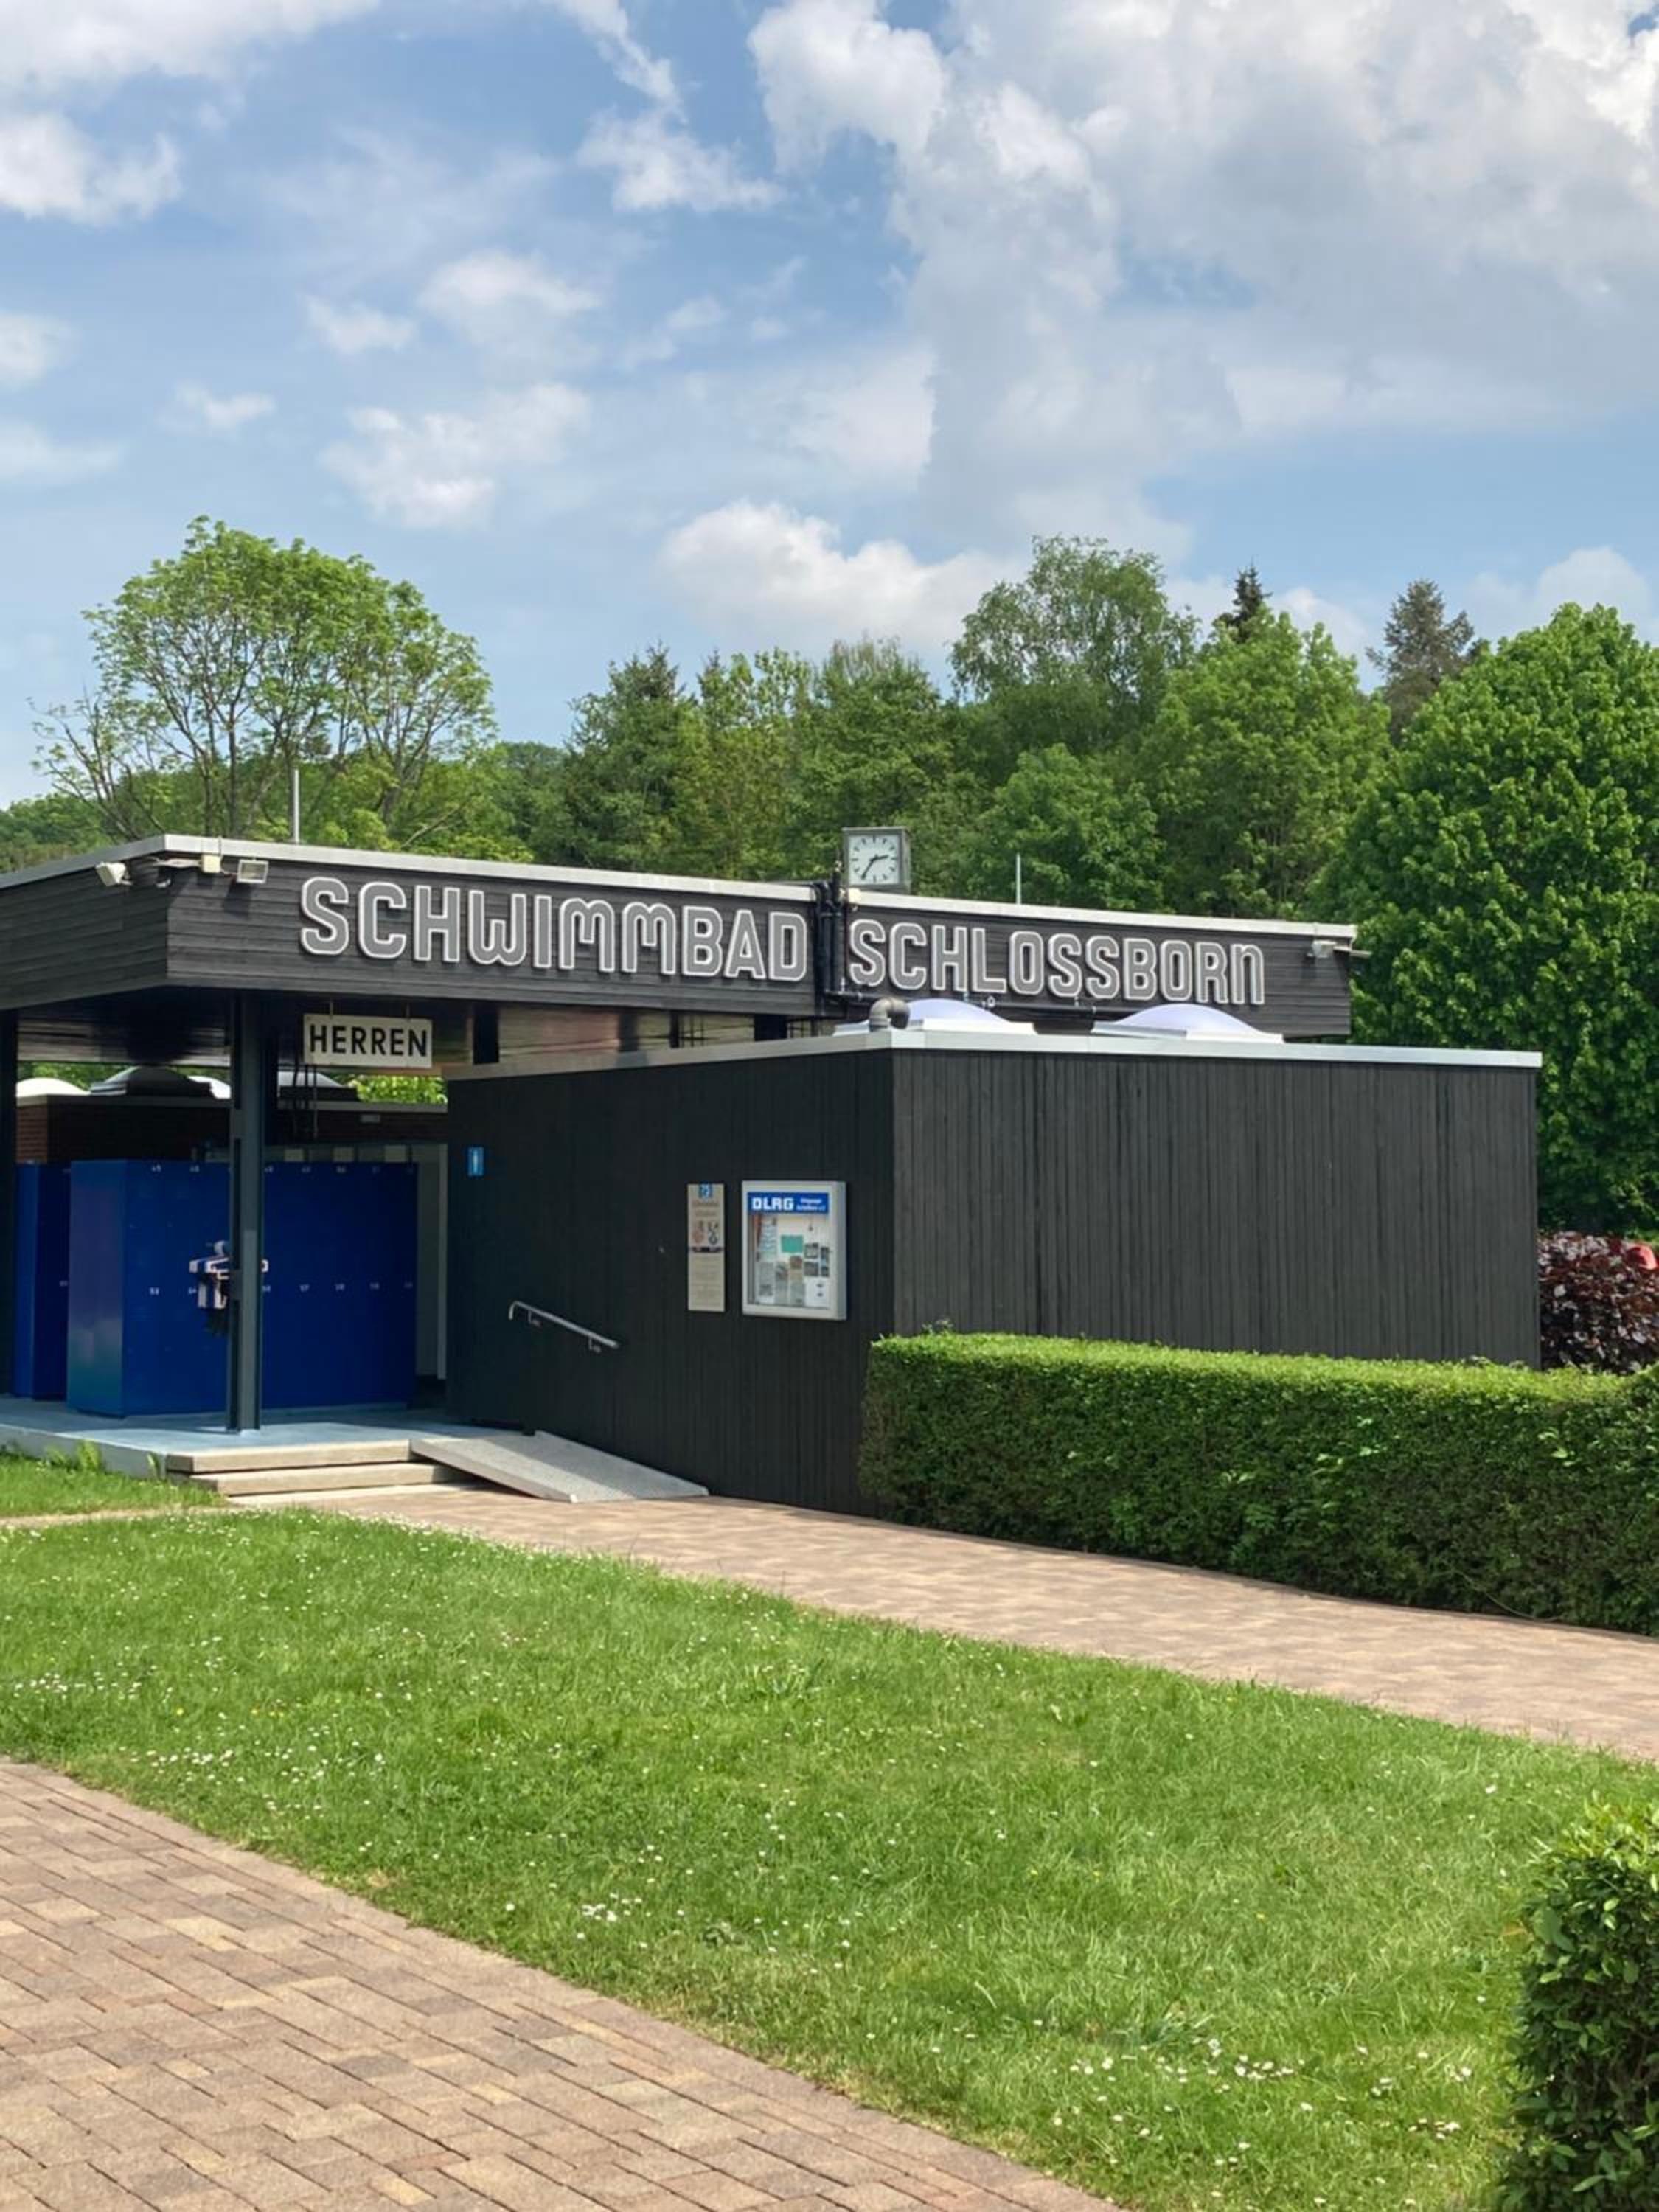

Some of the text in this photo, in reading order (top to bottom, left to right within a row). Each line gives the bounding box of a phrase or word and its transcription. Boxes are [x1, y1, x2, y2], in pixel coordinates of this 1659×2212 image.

[299, 876, 1266, 1005] SCHWIMMBAD SCHLOSSBORN
[309, 1024, 427, 1057] HERREN
